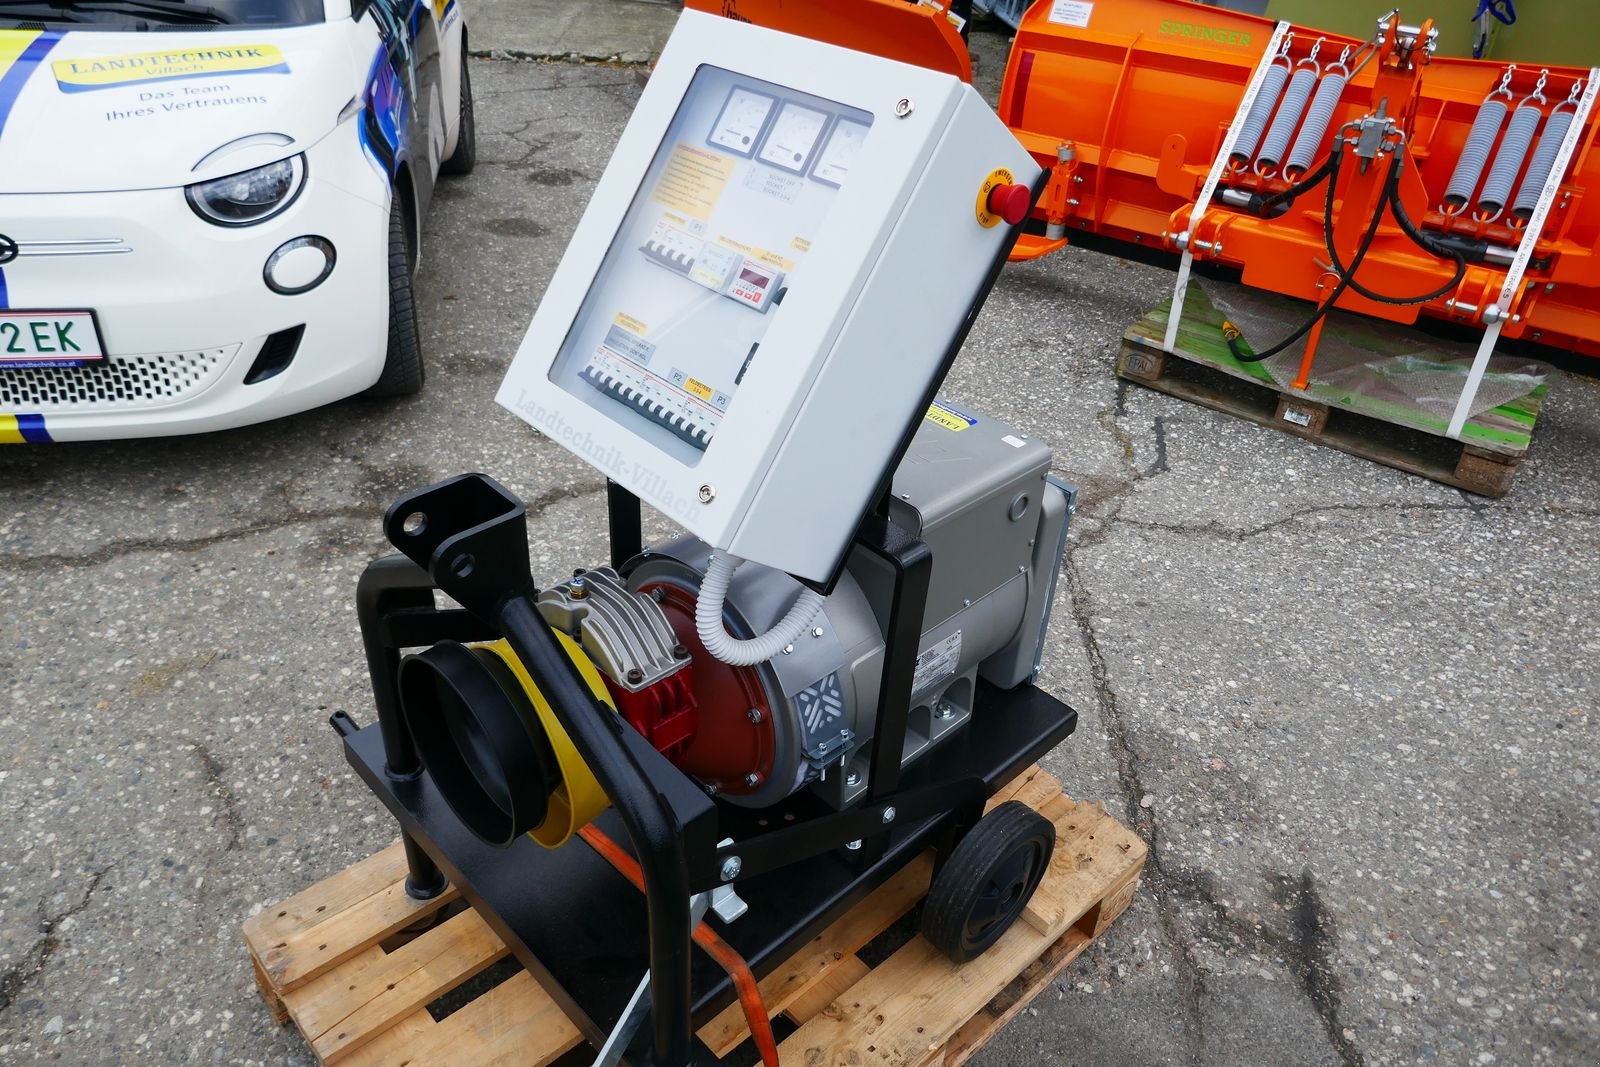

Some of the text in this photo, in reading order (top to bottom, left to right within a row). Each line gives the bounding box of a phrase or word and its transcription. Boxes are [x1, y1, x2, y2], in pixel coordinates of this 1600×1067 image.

[1158, 19, 1254, 46] SPRINGER
[69, 48, 264, 74] LANDTECHNIK
[145, 63, 204, 76] Villach
[139, 83, 231, 102] Das Team
[106, 94, 268, 122] Ihres Vertrauens
[995, 169, 1013, 186] EMERGEN
[979, 212, 989, 224] STOP
[29, 321, 81, 352] EK
[673, 372, 682, 382] P2
[717, 395, 727, 405] P3
[515, 388, 703, 525] Landtechnik-Villach
